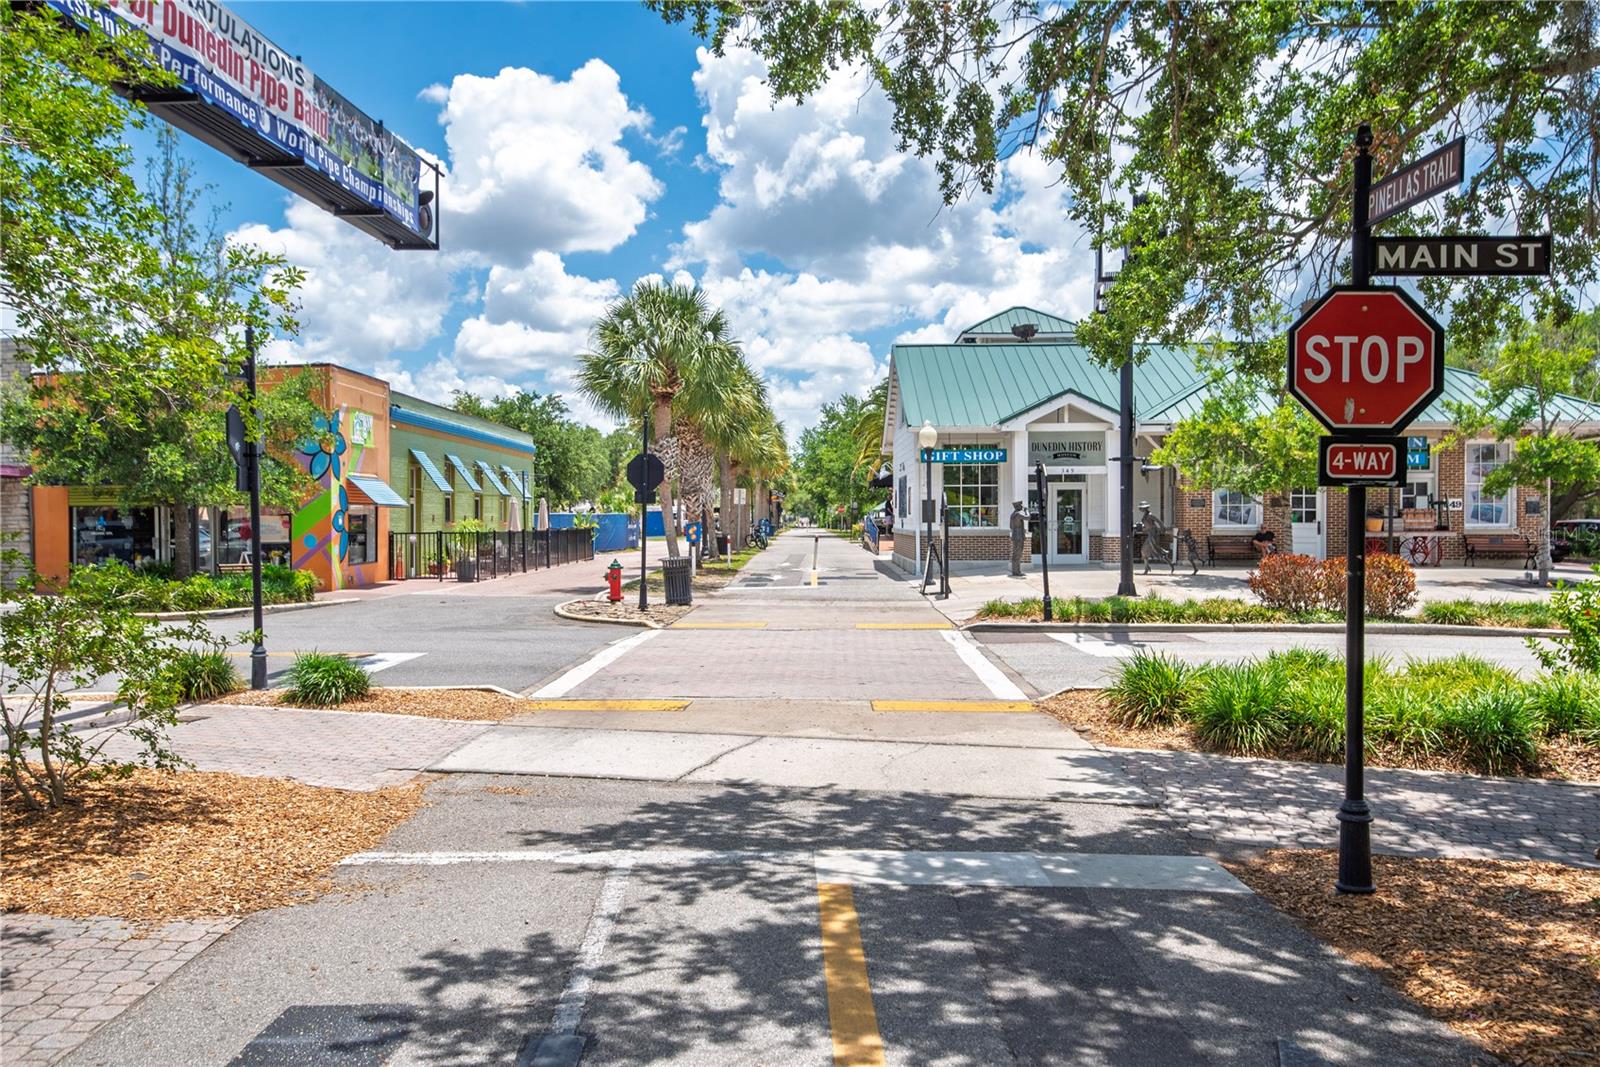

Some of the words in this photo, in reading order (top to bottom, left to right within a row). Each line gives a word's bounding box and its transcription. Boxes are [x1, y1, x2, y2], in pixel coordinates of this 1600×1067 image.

[187, 0, 305, 86] ATULATIONS
[163, 0, 244, 85] Dunedin
[249, 58, 289, 112] Pipe
[294, 87, 329, 142] Band
[159, 45, 257, 124] Performance
[276, 116, 316, 158] World
[318, 146, 340, 178] Pipe
[1368, 170, 1420, 220] PINELLAS
[1423, 151, 1457, 191] TRAIL
[1378, 243, 1478, 269] MAIN
[1495, 243, 1542, 268] ST
[1304, 334, 1425, 384] STOP
[963, 451, 1003, 461] SHOP
[1031, 441, 1067, 452] DUNEDIN
[1068, 440, 1103, 452] HISTORY
[1332, 451, 1390, 471] 4-WAY
